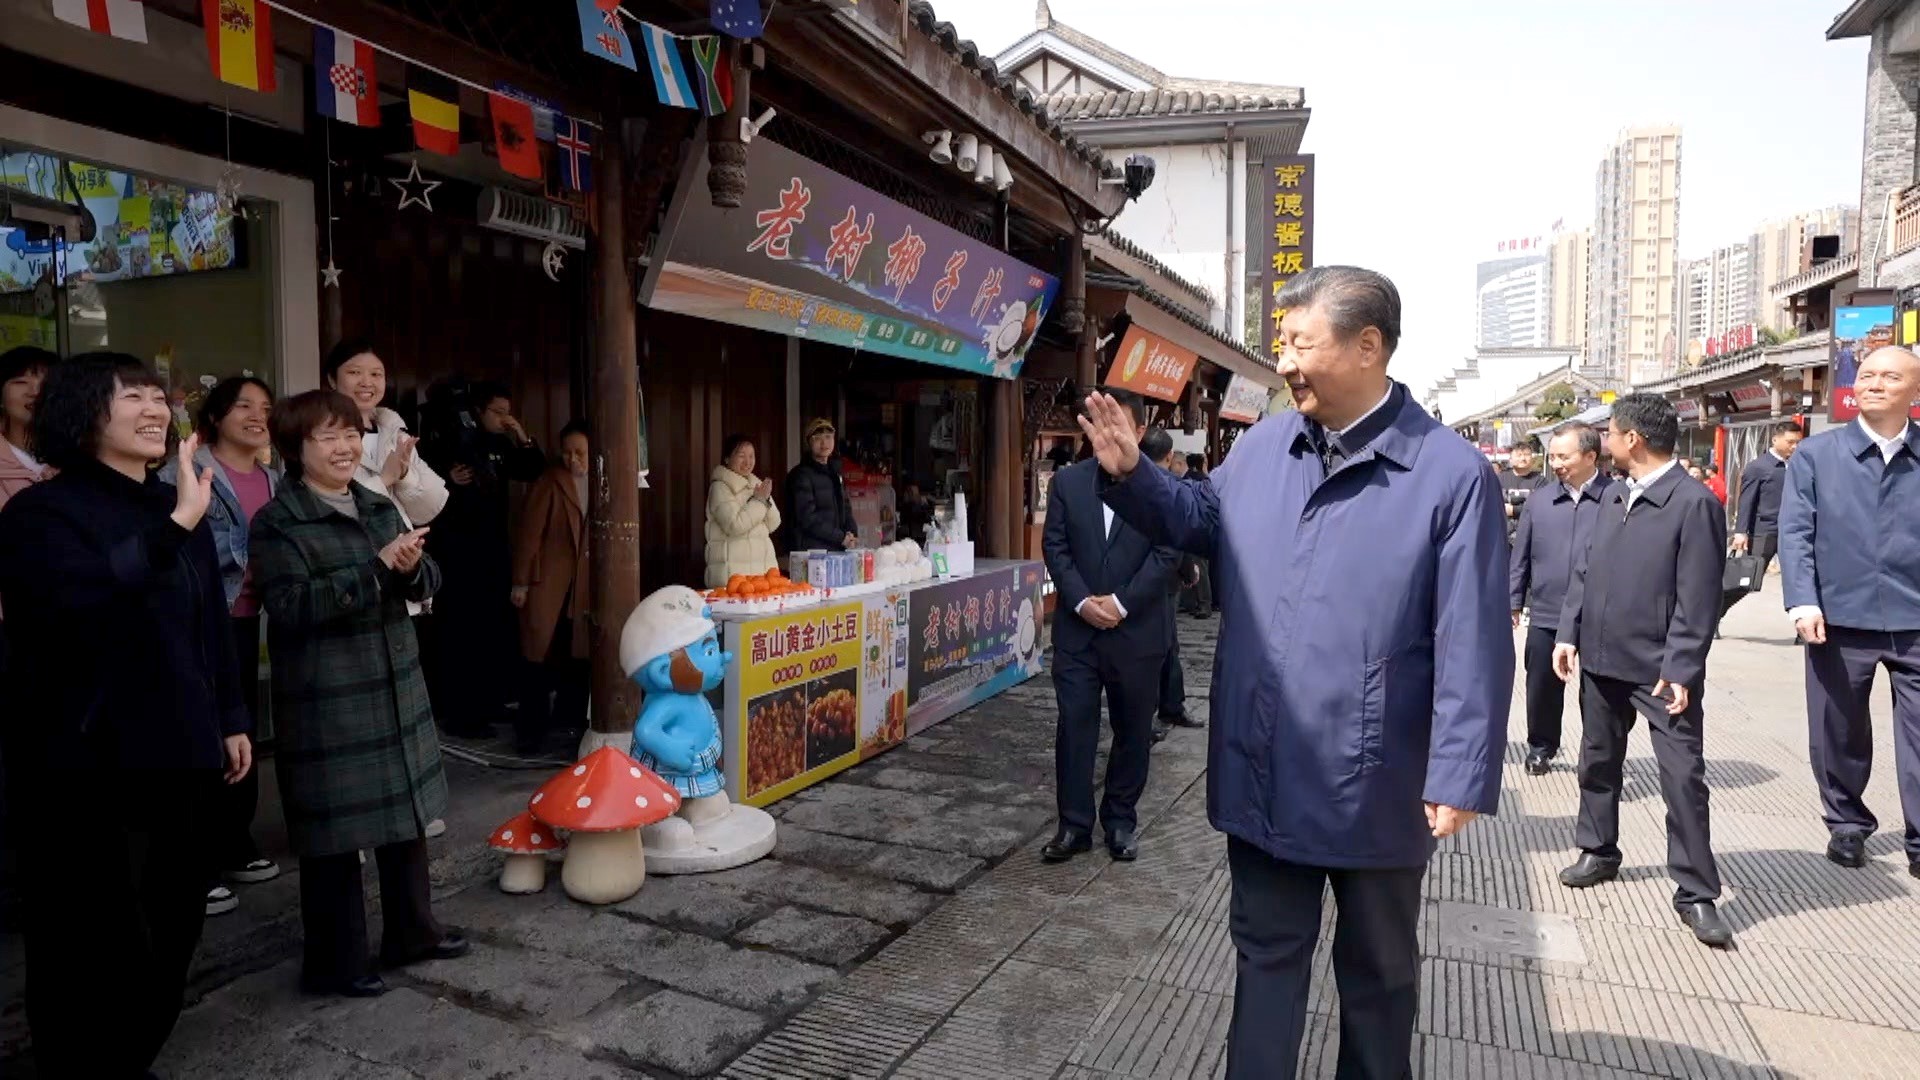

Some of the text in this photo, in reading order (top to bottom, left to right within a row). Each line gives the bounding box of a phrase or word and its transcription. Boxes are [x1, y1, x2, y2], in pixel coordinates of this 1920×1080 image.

[28, 257, 66, 278] Viy
[746, 177, 1004, 328] 老树椰子汁
[1271, 165, 1306, 353] 常德酱板
[751, 612, 857, 666] 高山黄金小土豆
[923, 585, 1011, 652] 老树椰子汁
